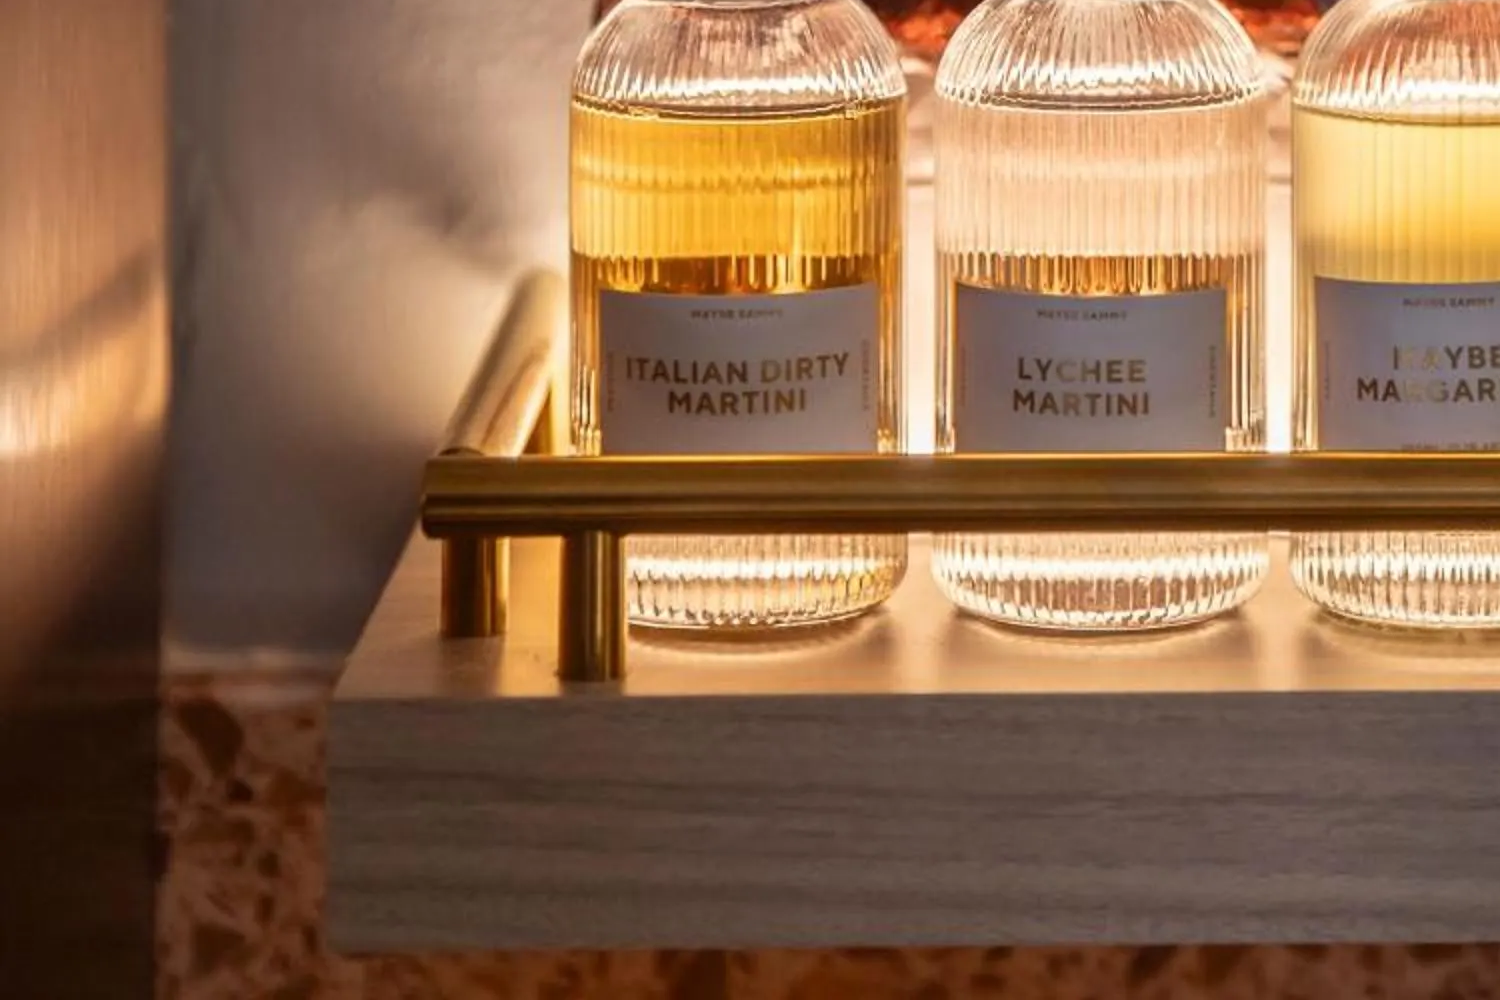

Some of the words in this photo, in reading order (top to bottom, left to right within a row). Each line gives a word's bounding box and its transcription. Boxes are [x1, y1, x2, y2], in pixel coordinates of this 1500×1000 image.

[626, 356, 749, 385] ITALIAN
[759, 351, 849, 384] DIRTY
[1017, 356, 1147, 384] LYCHEE
[667, 389, 807, 416] MARTINI
[1012, 389, 1150, 417] MARTINI
